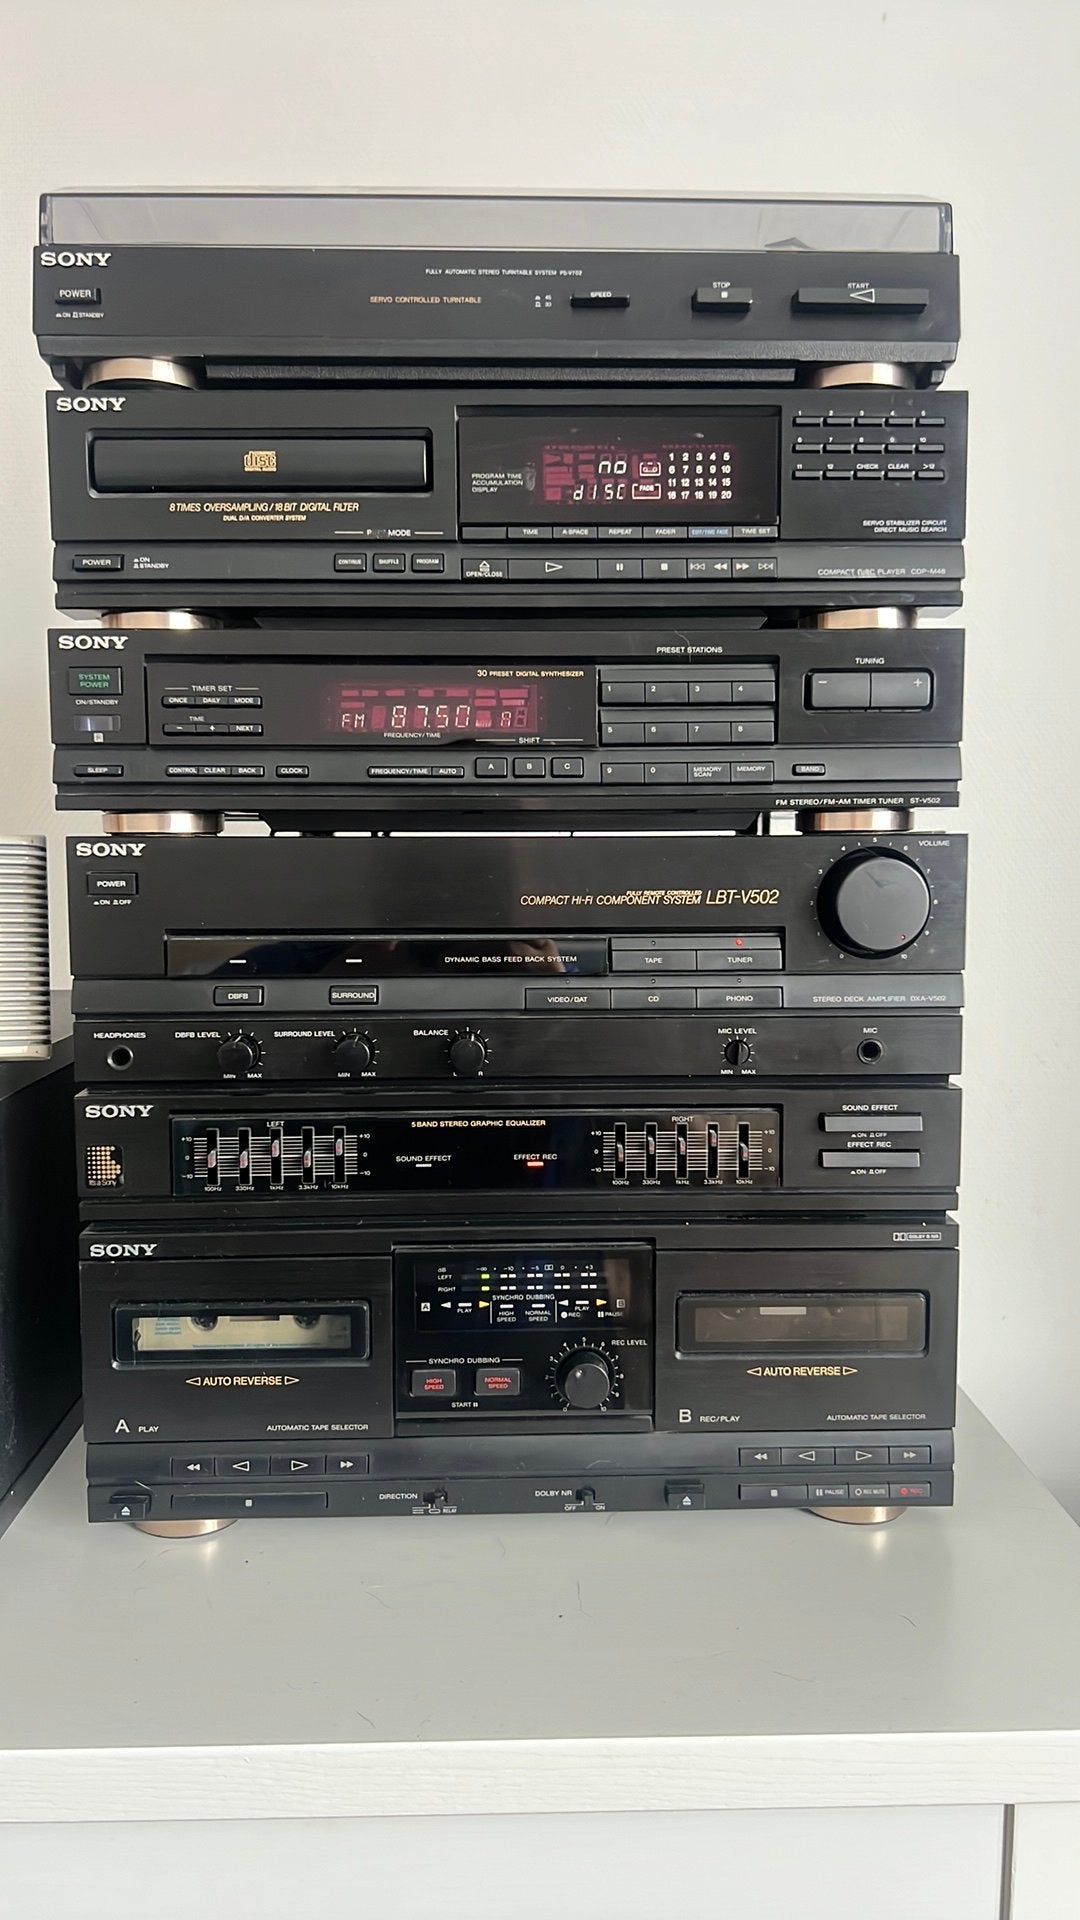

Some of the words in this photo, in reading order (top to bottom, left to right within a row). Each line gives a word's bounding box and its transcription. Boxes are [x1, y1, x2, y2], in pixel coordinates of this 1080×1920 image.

[41, 253, 111, 266] SONY
[57, 397, 126, 411] SONY
[669, 452, 674, 461] 1
[682, 452, 689, 461] 2
[696, 452, 703, 461] 3
[710, 452, 716, 461] 4
[723, 452, 730, 461] 5
[58, 636, 128, 650] SONY
[341, 714, 365, 728] FM
[392, 705, 470, 728] 87.50
[76, 844, 146, 856] SONY
[520, 895, 570, 905] COMPACT
[596, 896, 661, 904] COMPONENT
[663, 896, 701, 904] SYSTEM
[706, 890, 779, 904] LBT-V502
[86, 1106, 153, 1118] SONY
[90, 1244, 157, 1257] SONY
[764, 1366, 791, 1376] AUTO
[793, 1366, 841, 1376] REVERSE
[203, 1376, 231, 1386] AUTO
[233, 1376, 282, 1386] REVERSE
[679, 1409, 691, 1422] B
[115, 1419, 130, 1433] A
